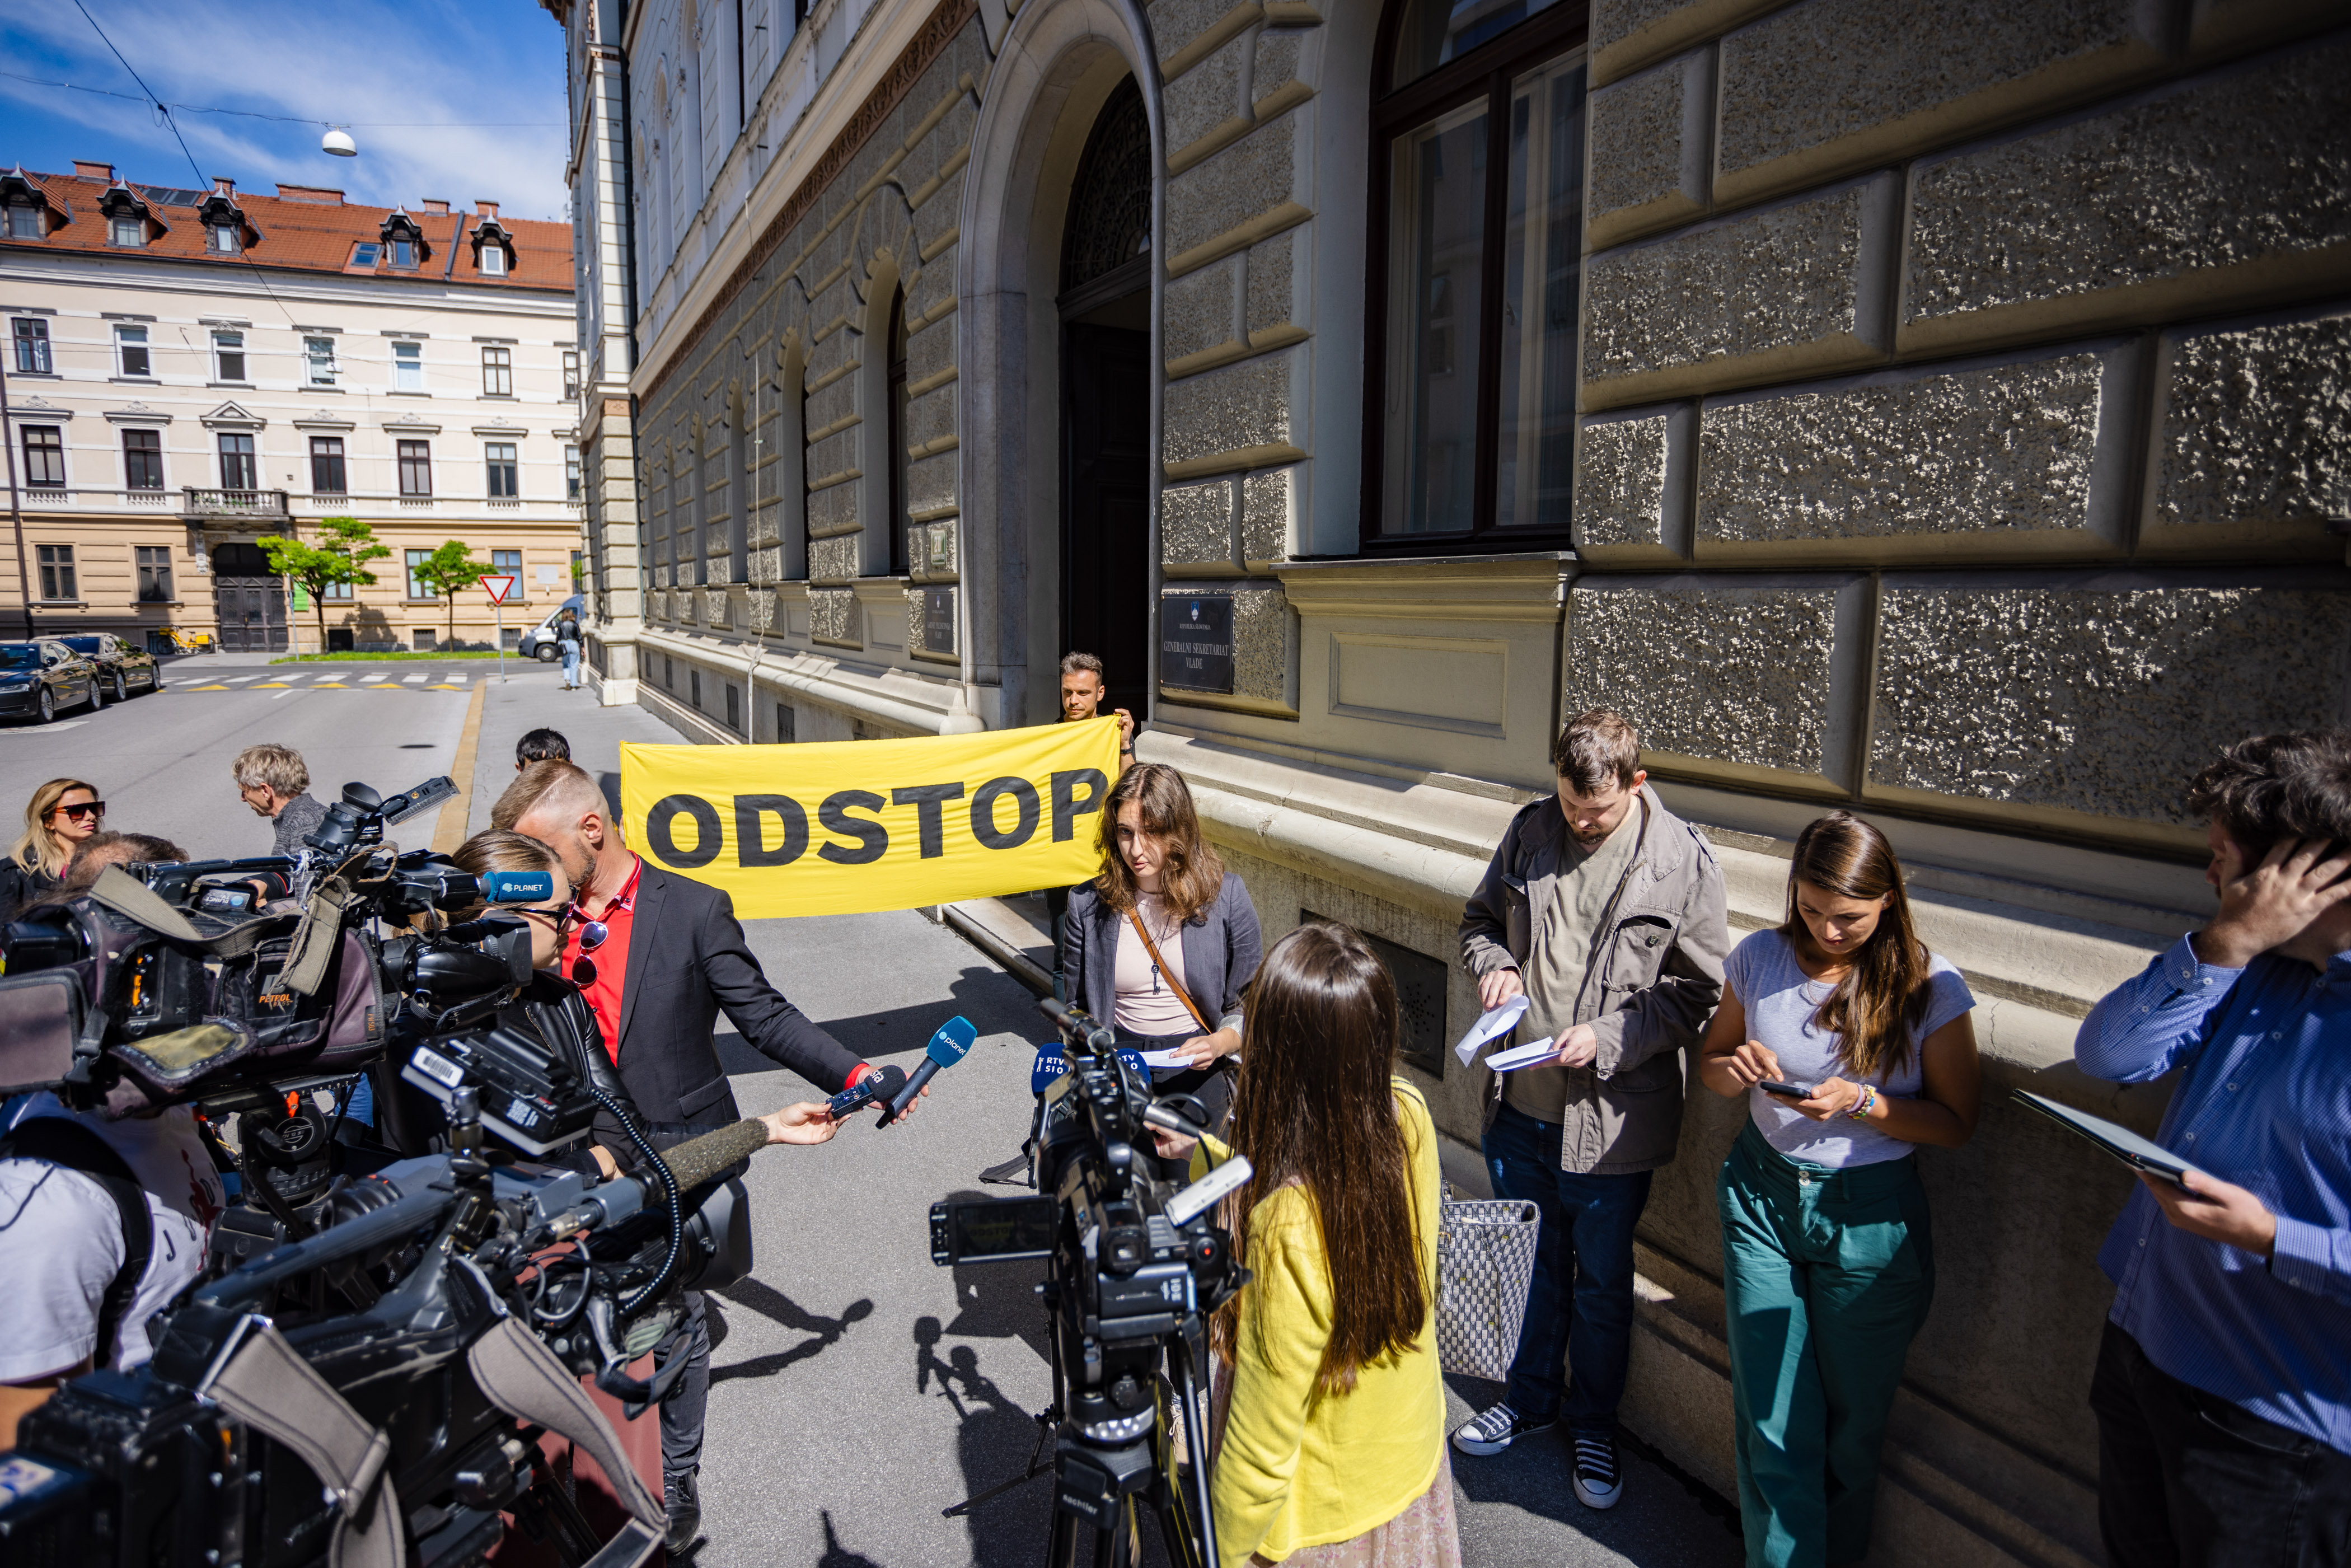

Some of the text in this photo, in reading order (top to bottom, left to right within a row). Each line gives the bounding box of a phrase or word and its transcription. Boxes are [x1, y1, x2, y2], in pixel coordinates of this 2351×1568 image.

[934, 536, 941, 553] 20
[1164, 641, 1229, 656] GENERALNI SEKRETARIAT
[1186, 657, 1203, 669] VLADE
[647, 767, 1108, 869] ODSTOP
[259, 994, 291, 1004] PETROL
[944, 1037, 966, 1055] planet
[1046, 1057, 1065, 1065] RTV
